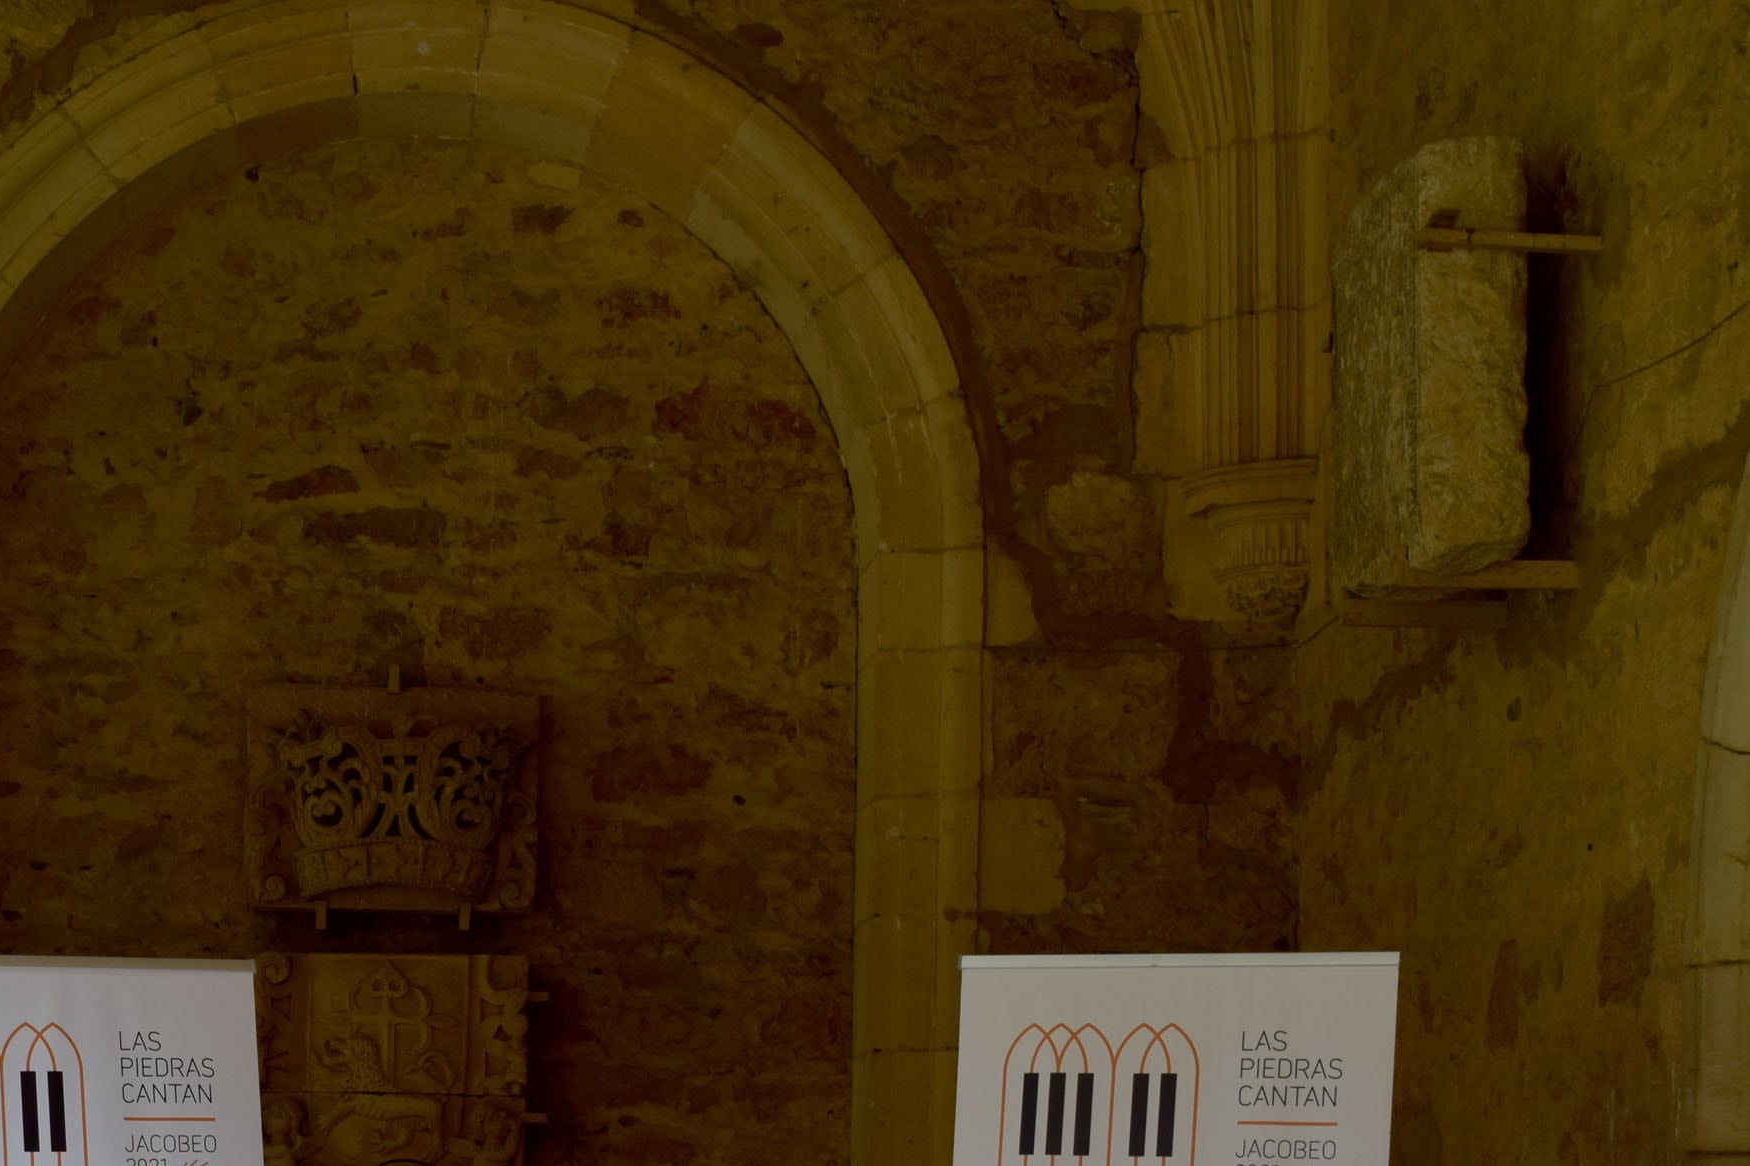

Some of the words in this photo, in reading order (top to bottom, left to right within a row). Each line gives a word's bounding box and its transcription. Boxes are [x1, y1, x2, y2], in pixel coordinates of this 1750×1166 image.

[118, 1031, 162, 1051] LAS
[1241, 1030, 1288, 1052] LAS
[120, 1057, 216, 1078] PIEDRAS
[1239, 1057, 1344, 1080] PIEDRAS
[121, 1083, 213, 1104] CANTAN
[1237, 1085, 1338, 1108] CANTAN
[124, 1134, 218, 1154] JACOBEO
[1234, 1139, 1337, 1160] JACOBEO
